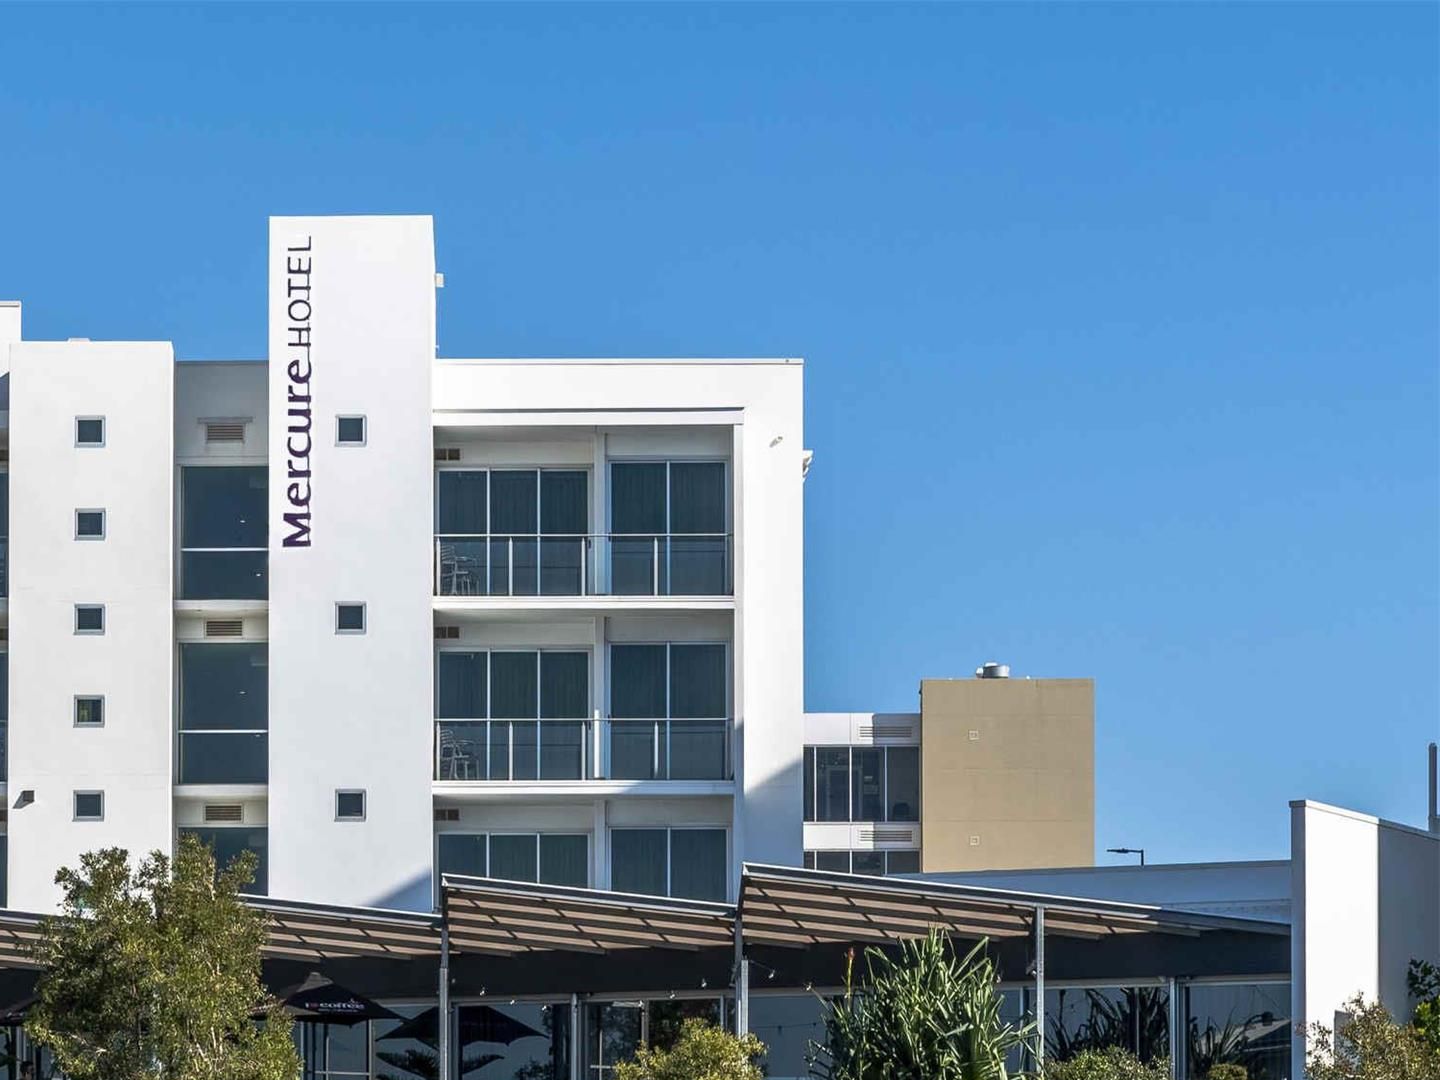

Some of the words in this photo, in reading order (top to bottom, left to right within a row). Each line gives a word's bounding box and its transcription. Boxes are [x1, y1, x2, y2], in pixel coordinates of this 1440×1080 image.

[287, 235, 312, 347] HOTEL
[282, 359, 312, 548] Mercure
[319, 1000, 365, 1009] coffee
